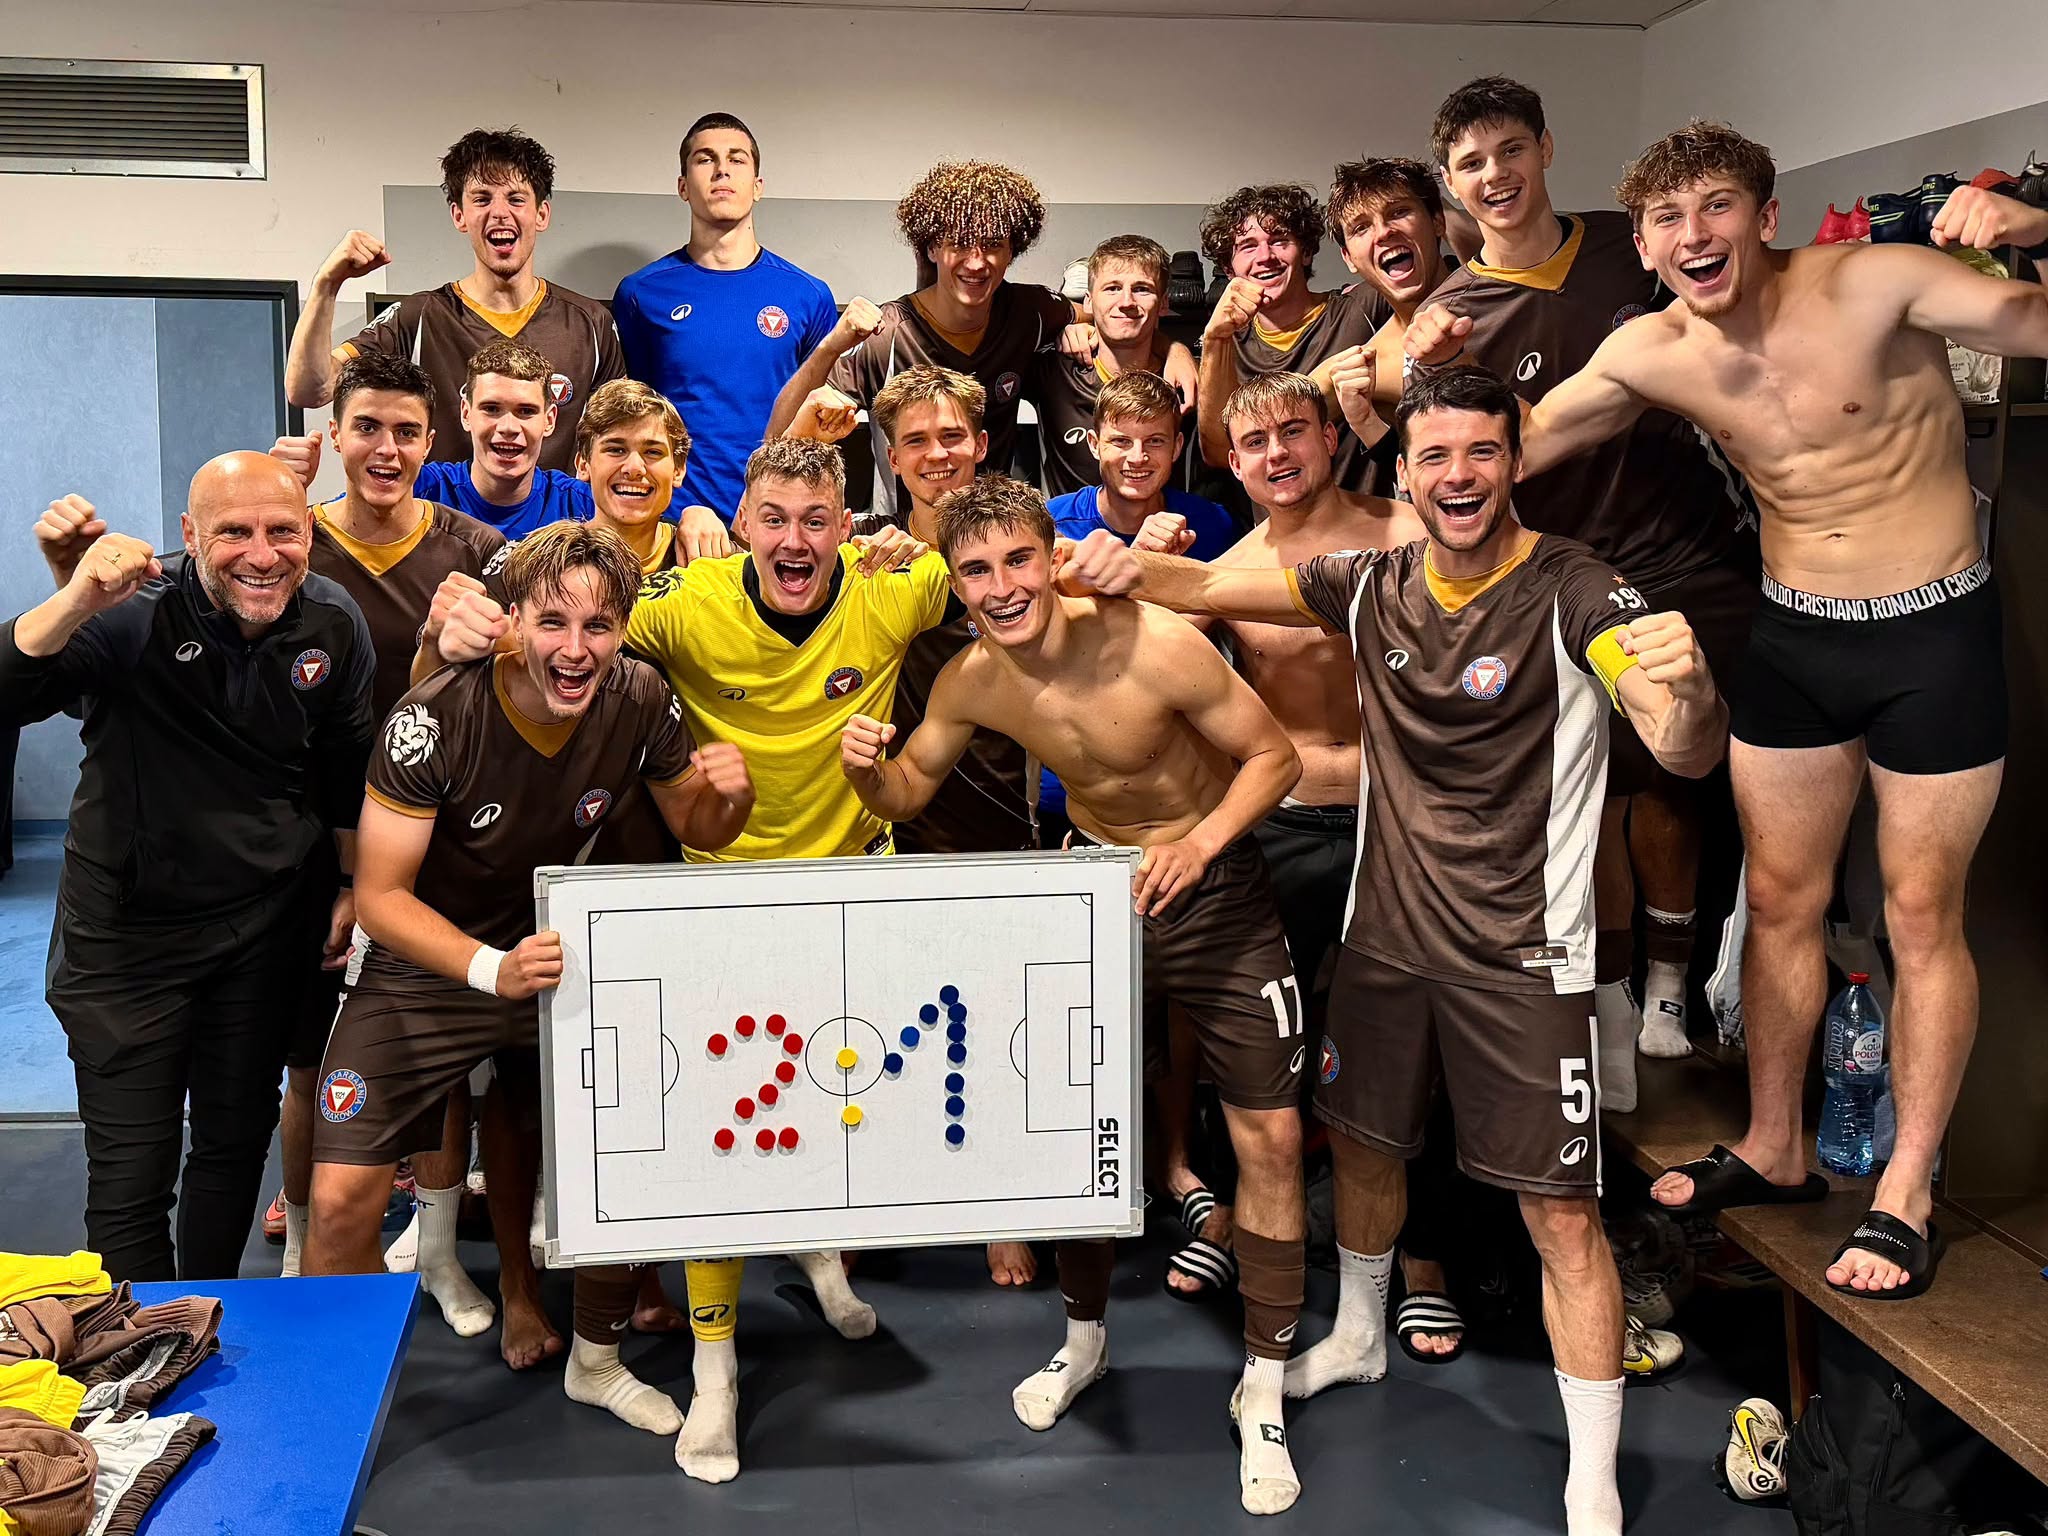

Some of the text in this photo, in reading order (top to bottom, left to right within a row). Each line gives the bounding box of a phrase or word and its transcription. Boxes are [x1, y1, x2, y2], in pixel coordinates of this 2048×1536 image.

[1795, 591, 1869, 621] CRISTIANO
[1871, 582, 1946, 620] RONALDO
[1260, 974, 1303, 1039] 17
[330, 1071, 366, 1105] GARBARNIA
[1559, 1058, 1591, 1124] 5
[1098, 1117, 1119, 1199] SELECT
[1252, 1477, 1258, 1485] R
